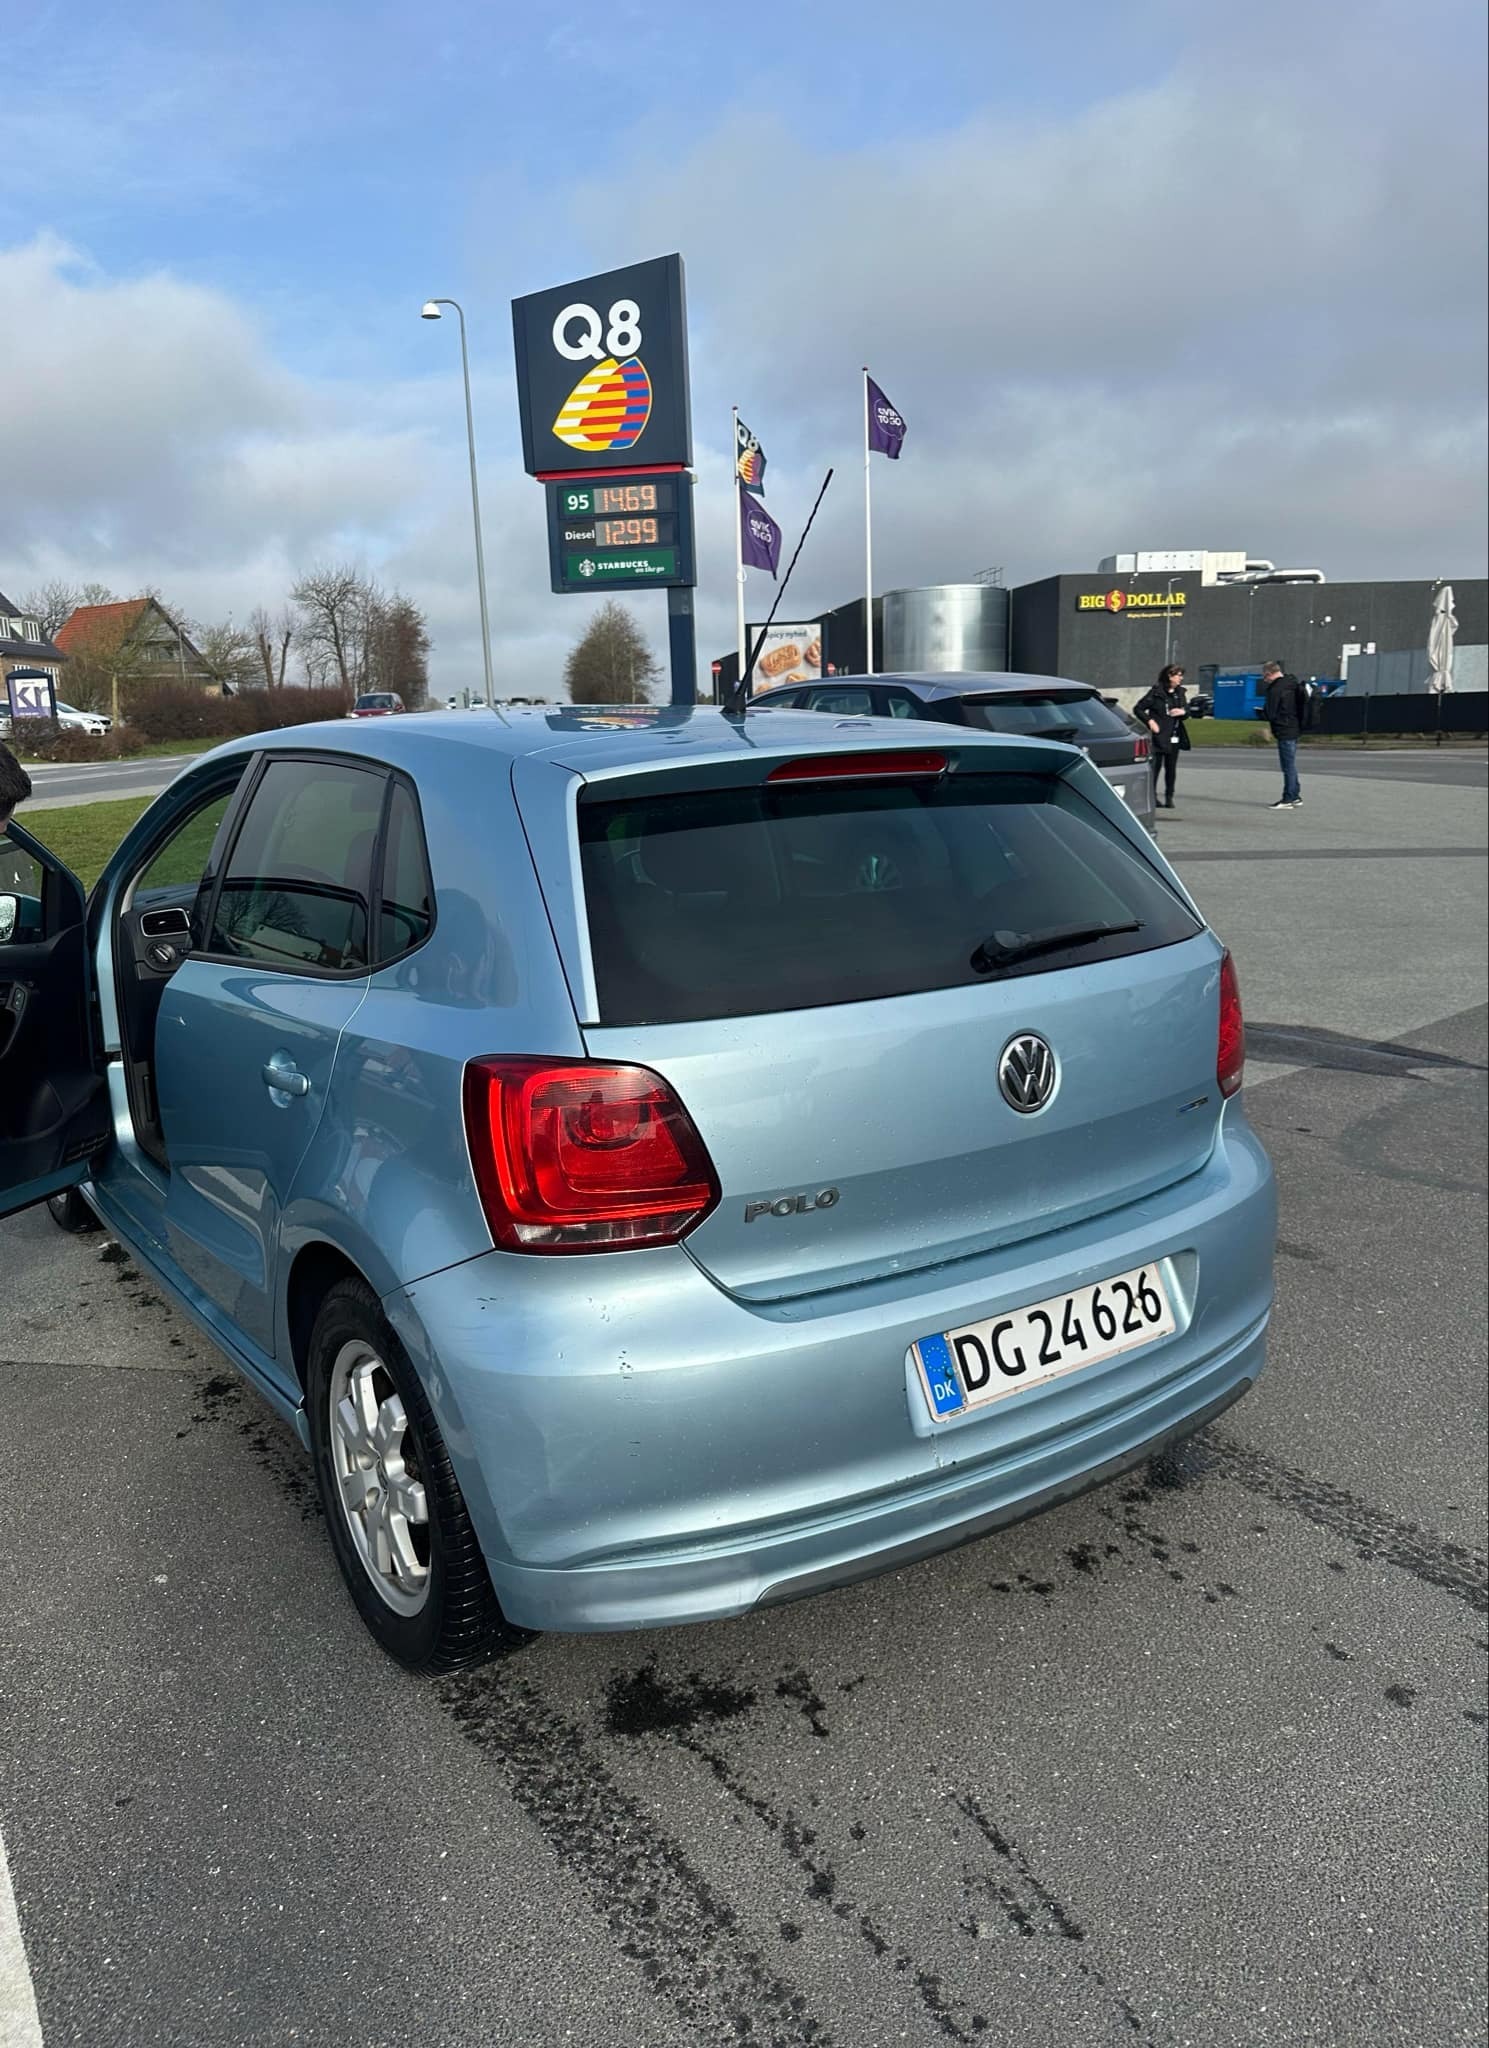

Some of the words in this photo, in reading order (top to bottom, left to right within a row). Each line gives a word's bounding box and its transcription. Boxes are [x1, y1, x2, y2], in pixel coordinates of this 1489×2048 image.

[552, 299, 642, 361] Q8
[738, 424, 759, 451] Q8
[567, 494, 590, 511] 95
[564, 529, 596, 541] Diesel
[598, 560, 649, 571] STARBUCKS
[1079, 595, 1105, 609] BIG
[1126, 592, 1186, 607] DOLLAR
[743, 1186, 840, 1224] POLO
[953, 1320, 1026, 1392] DG
[1027, 1298, 1089, 1366] 24
[1091, 1270, 1163, 1341] 626
[934, 1379, 956, 1402] DK
